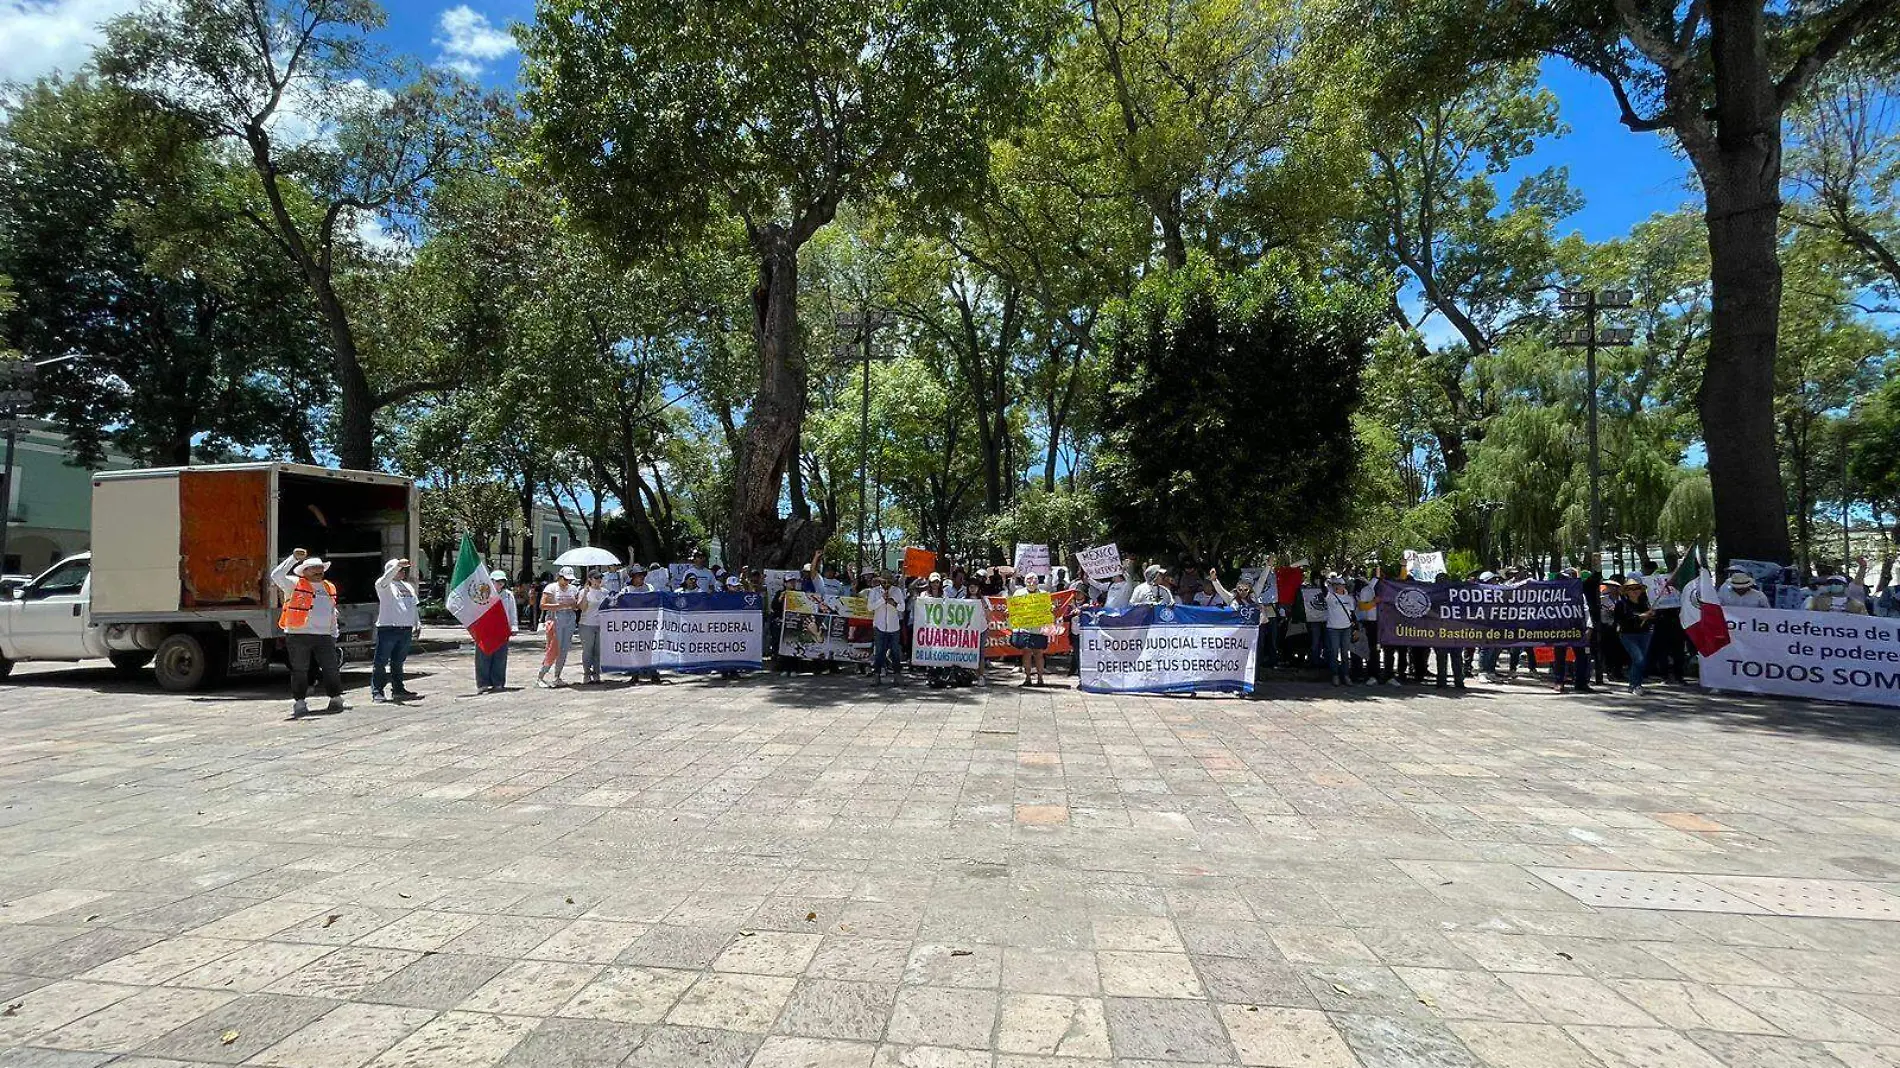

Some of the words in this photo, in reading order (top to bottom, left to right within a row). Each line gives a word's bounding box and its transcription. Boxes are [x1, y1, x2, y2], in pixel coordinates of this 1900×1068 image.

[1450, 588, 1504, 603] PODER
[1508, 588, 1571, 603] JUDICIAL
[925, 604, 943, 626] YO
[947, 603, 976, 626] SOY
[1440, 605, 1461, 619] DE
[1466, 606, 1485, 620] LA
[1490, 603, 1583, 620] FEDERACIÓN
[607, 621, 619, 632] EL
[622, 620, 658, 632] PODER
[661, 620, 704, 633] JUDICIAL
[708, 621, 753, 632] FEDERAL
[1396, 624, 1435, 638] Último
[1439, 628, 1483, 639] Bastión
[1486, 629, 1501, 640] de
[1504, 629, 1514, 639] la
[1518, 628, 1581, 639] Democracia
[1726, 621, 1746, 631] or
[1752, 619, 1769, 632] la
[1776, 620, 1858, 639] defensa
[1864, 627, 1890, 641] de
[917, 622, 978, 648] GUARDIÁN
[615, 640, 664, 652] DEFIENDE
[667, 641, 685, 653] TUS
[689, 642, 746, 653] DERECHOS
[1089, 640, 1101, 650] EL
[1105, 640, 1142, 650] PODER
[1146, 637, 1198, 649] JUDICIAL
[1201, 638, 1248, 649] FEDERAL
[916, 650, 923, 659] DE
[925, 651, 932, 660] LA
[1788, 642, 1814, 656] de
[1820, 646, 1900, 662] podere
[1097, 661, 1151, 672] DEFIENDE
[1157, 660, 1179, 671] TUS
[1182, 659, 1239, 671] DERECHOS
[1726, 660, 1825, 684] TODOS
